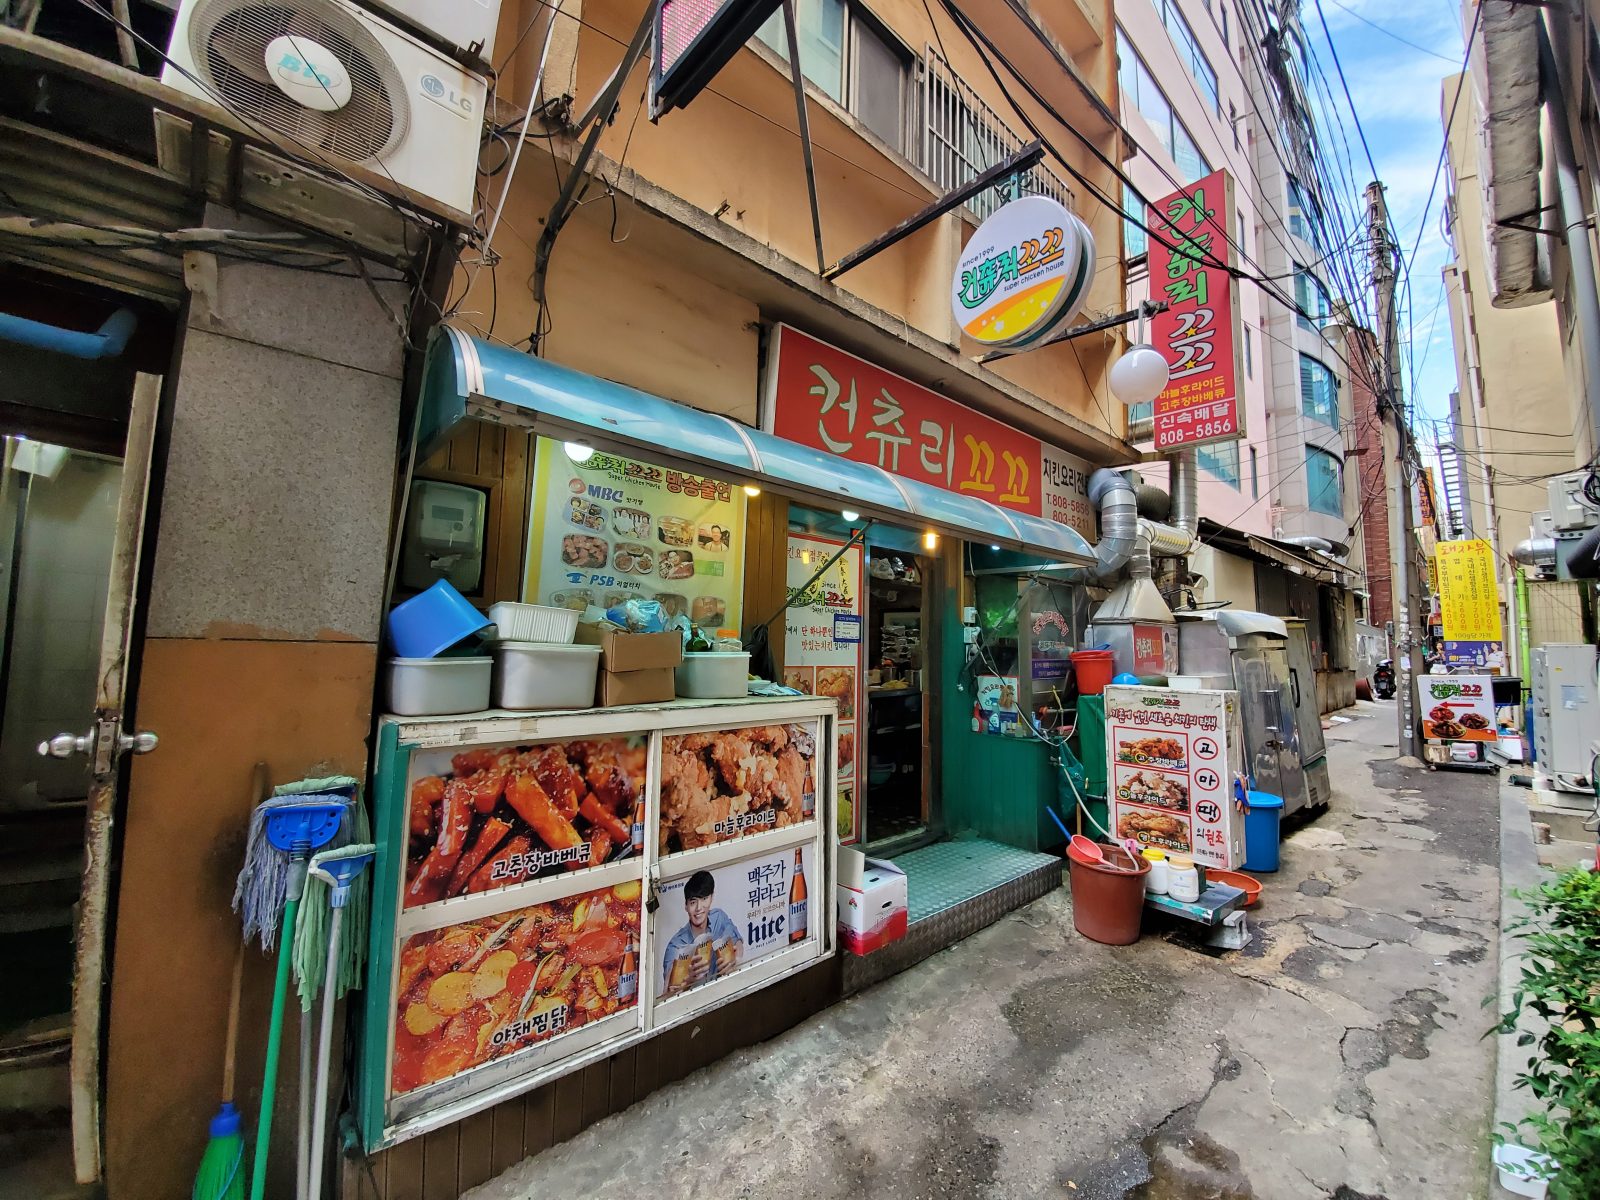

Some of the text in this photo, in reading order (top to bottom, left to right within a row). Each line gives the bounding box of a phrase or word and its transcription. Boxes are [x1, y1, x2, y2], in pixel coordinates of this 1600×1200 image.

[449, 91, 473, 113] LG
[1004, 260, 1065, 292] super chicken house
[1159, 375, 1225, 400] 마늘후라이드
[1160, 388, 1226, 412] 고추장바베큐
[1160, 402, 1230, 430] 신속배달
[1160, 419, 1232, 445] 808-5856
[588, 484, 623, 503] MBC
[666, 470, 732, 502] 방송출연
[590, 575, 615, 586] PSB
[1149, 711, 1173, 726] 새로운
[1173, 712, 1197, 729] 치킨의
[1198, 715, 1217, 731] 탄생
[714, 809, 776, 835] 마늘후라이드
[491, 841, 592, 880] 고추장바베큐
[748, 860, 786, 886] 맥주가
[748, 881, 786, 908] 뭐라고
[748, 914, 786, 945] hite
[491, 1005, 567, 1045] 야채찜닭
